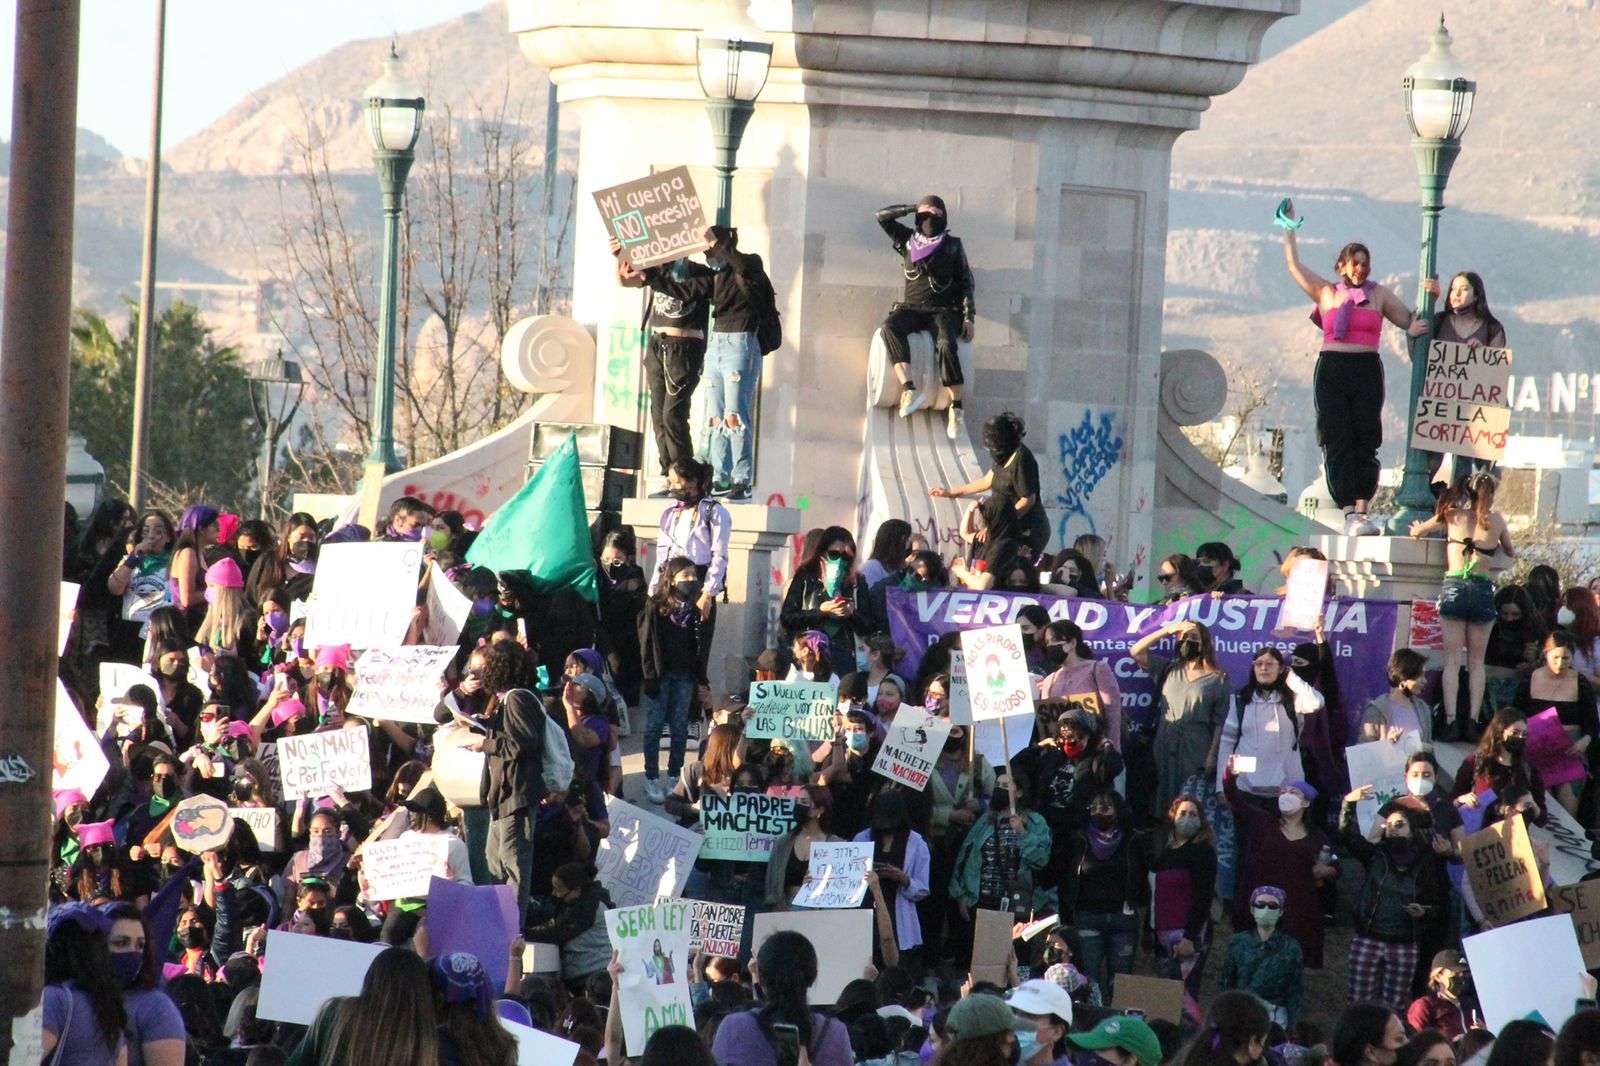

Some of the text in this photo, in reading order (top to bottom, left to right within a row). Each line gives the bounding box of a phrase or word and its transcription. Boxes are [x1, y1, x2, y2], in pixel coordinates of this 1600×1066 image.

[600, 191, 621, 219] Mi
[616, 193, 700, 239] NO necesita
[1429, 341, 1509, 366] SI LA USA
[1426, 364, 1468, 380] PARA
[1425, 380, 1502, 403] VIOLAR
[1417, 400, 1487, 422] SE LA
[1415, 421, 1509, 448] CORTAMOS
[1124, 605, 1156, 634] Y
[1160, 598, 1368, 634] JUSTIIA
[985, 632, 1022, 660] PIROPO
[1336, 640, 1353, 657] la
[814, 702, 834, 716] CON
[756, 717, 776, 732] LAS
[284, 739, 307, 760] NO
[885, 744, 933, 774] MACHETE
[877, 758, 889, 771] AL
[702, 794, 793, 816] UN PADRE
[704, 812, 797, 836] MACHIST
[1473, 841, 1505, 868] ESTO
[1559, 887, 1586, 913] SE
[662, 903, 688, 931] LEY
